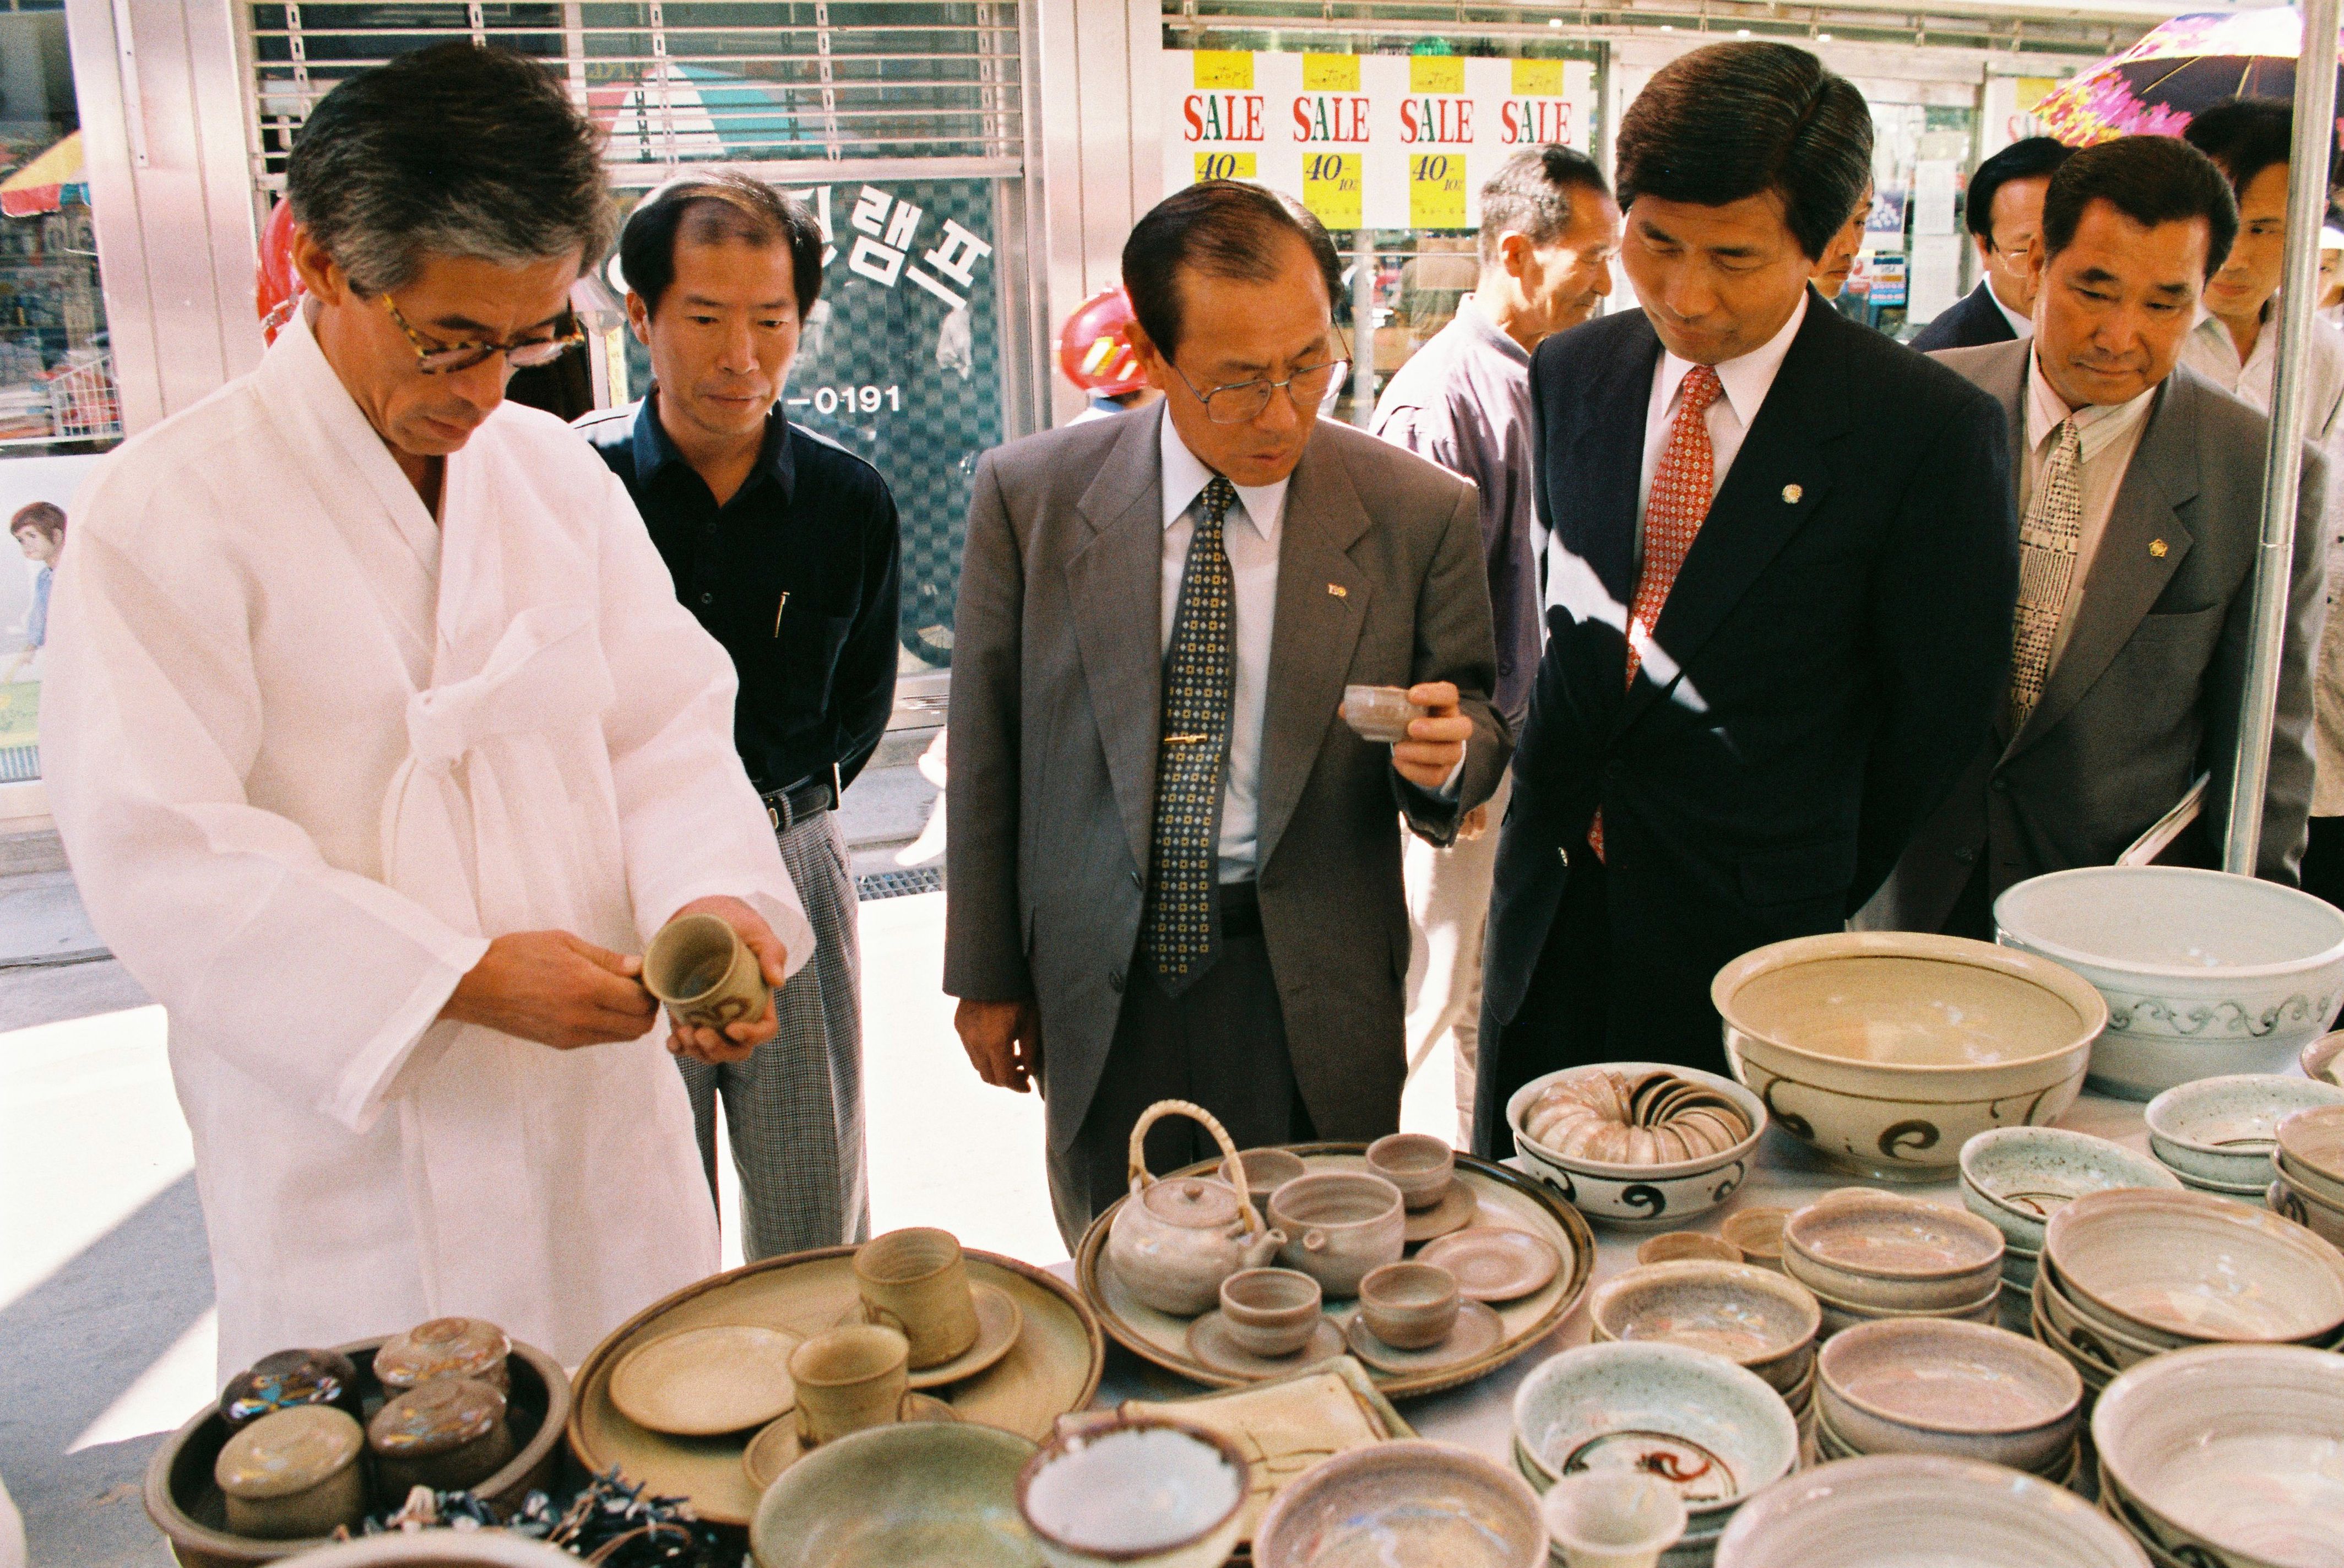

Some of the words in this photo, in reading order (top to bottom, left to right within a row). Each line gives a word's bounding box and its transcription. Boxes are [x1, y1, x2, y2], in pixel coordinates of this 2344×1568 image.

[1184, 94, 1265, 142] SALE
[1293, 96, 1370, 143] SALE
[1400, 98, 1474, 144] SALE
[1501, 100, 1572, 145] SALE
